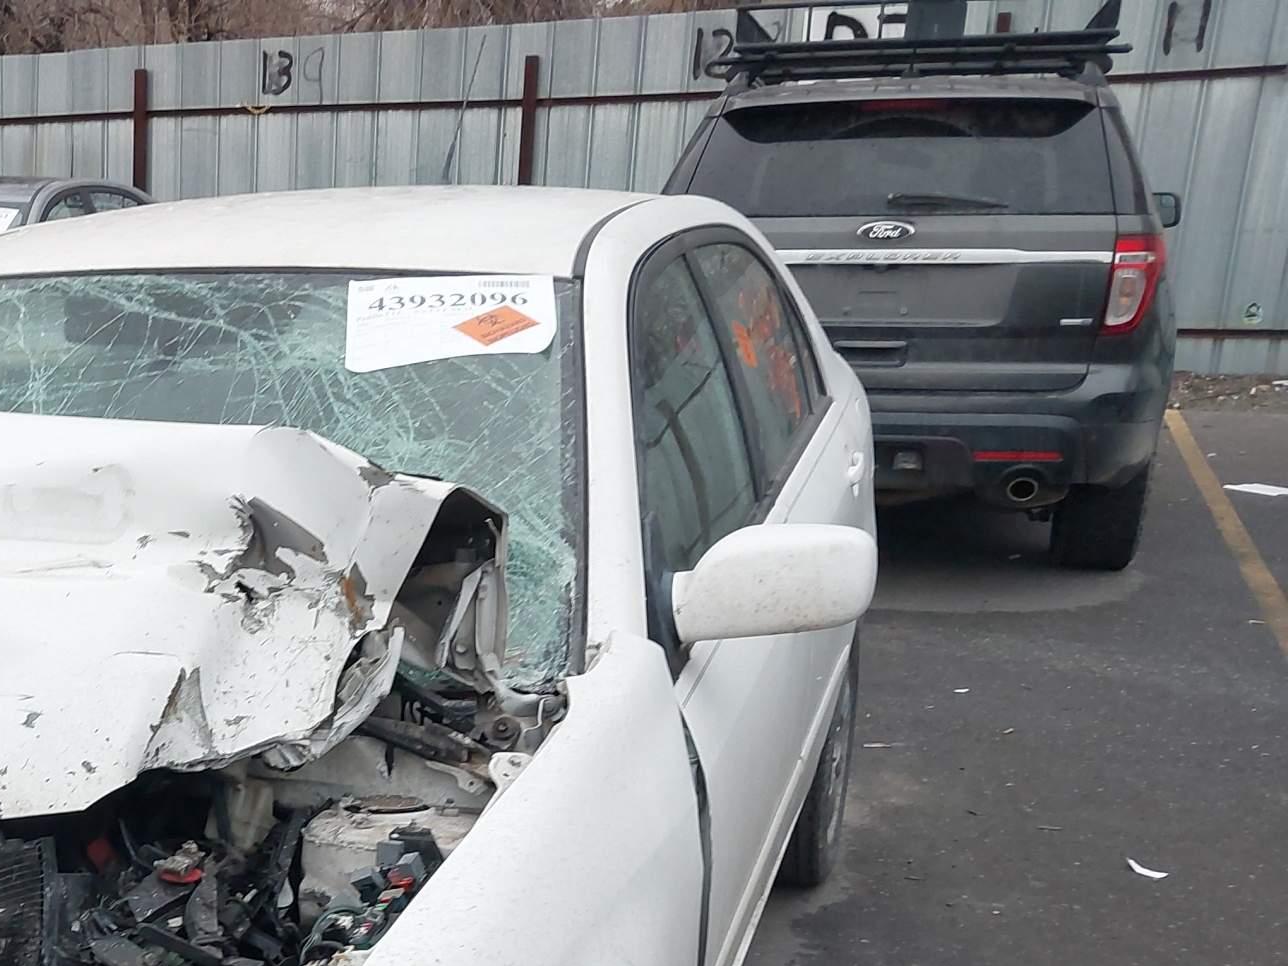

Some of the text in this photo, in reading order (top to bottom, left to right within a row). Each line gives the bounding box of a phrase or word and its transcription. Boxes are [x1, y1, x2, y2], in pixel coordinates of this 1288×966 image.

[261, 50, 293, 95] 13
[868, 223, 903, 239] Ford
[805, 254, 962, 262] EXPLORER
[368, 291, 529, 312] 43932096
